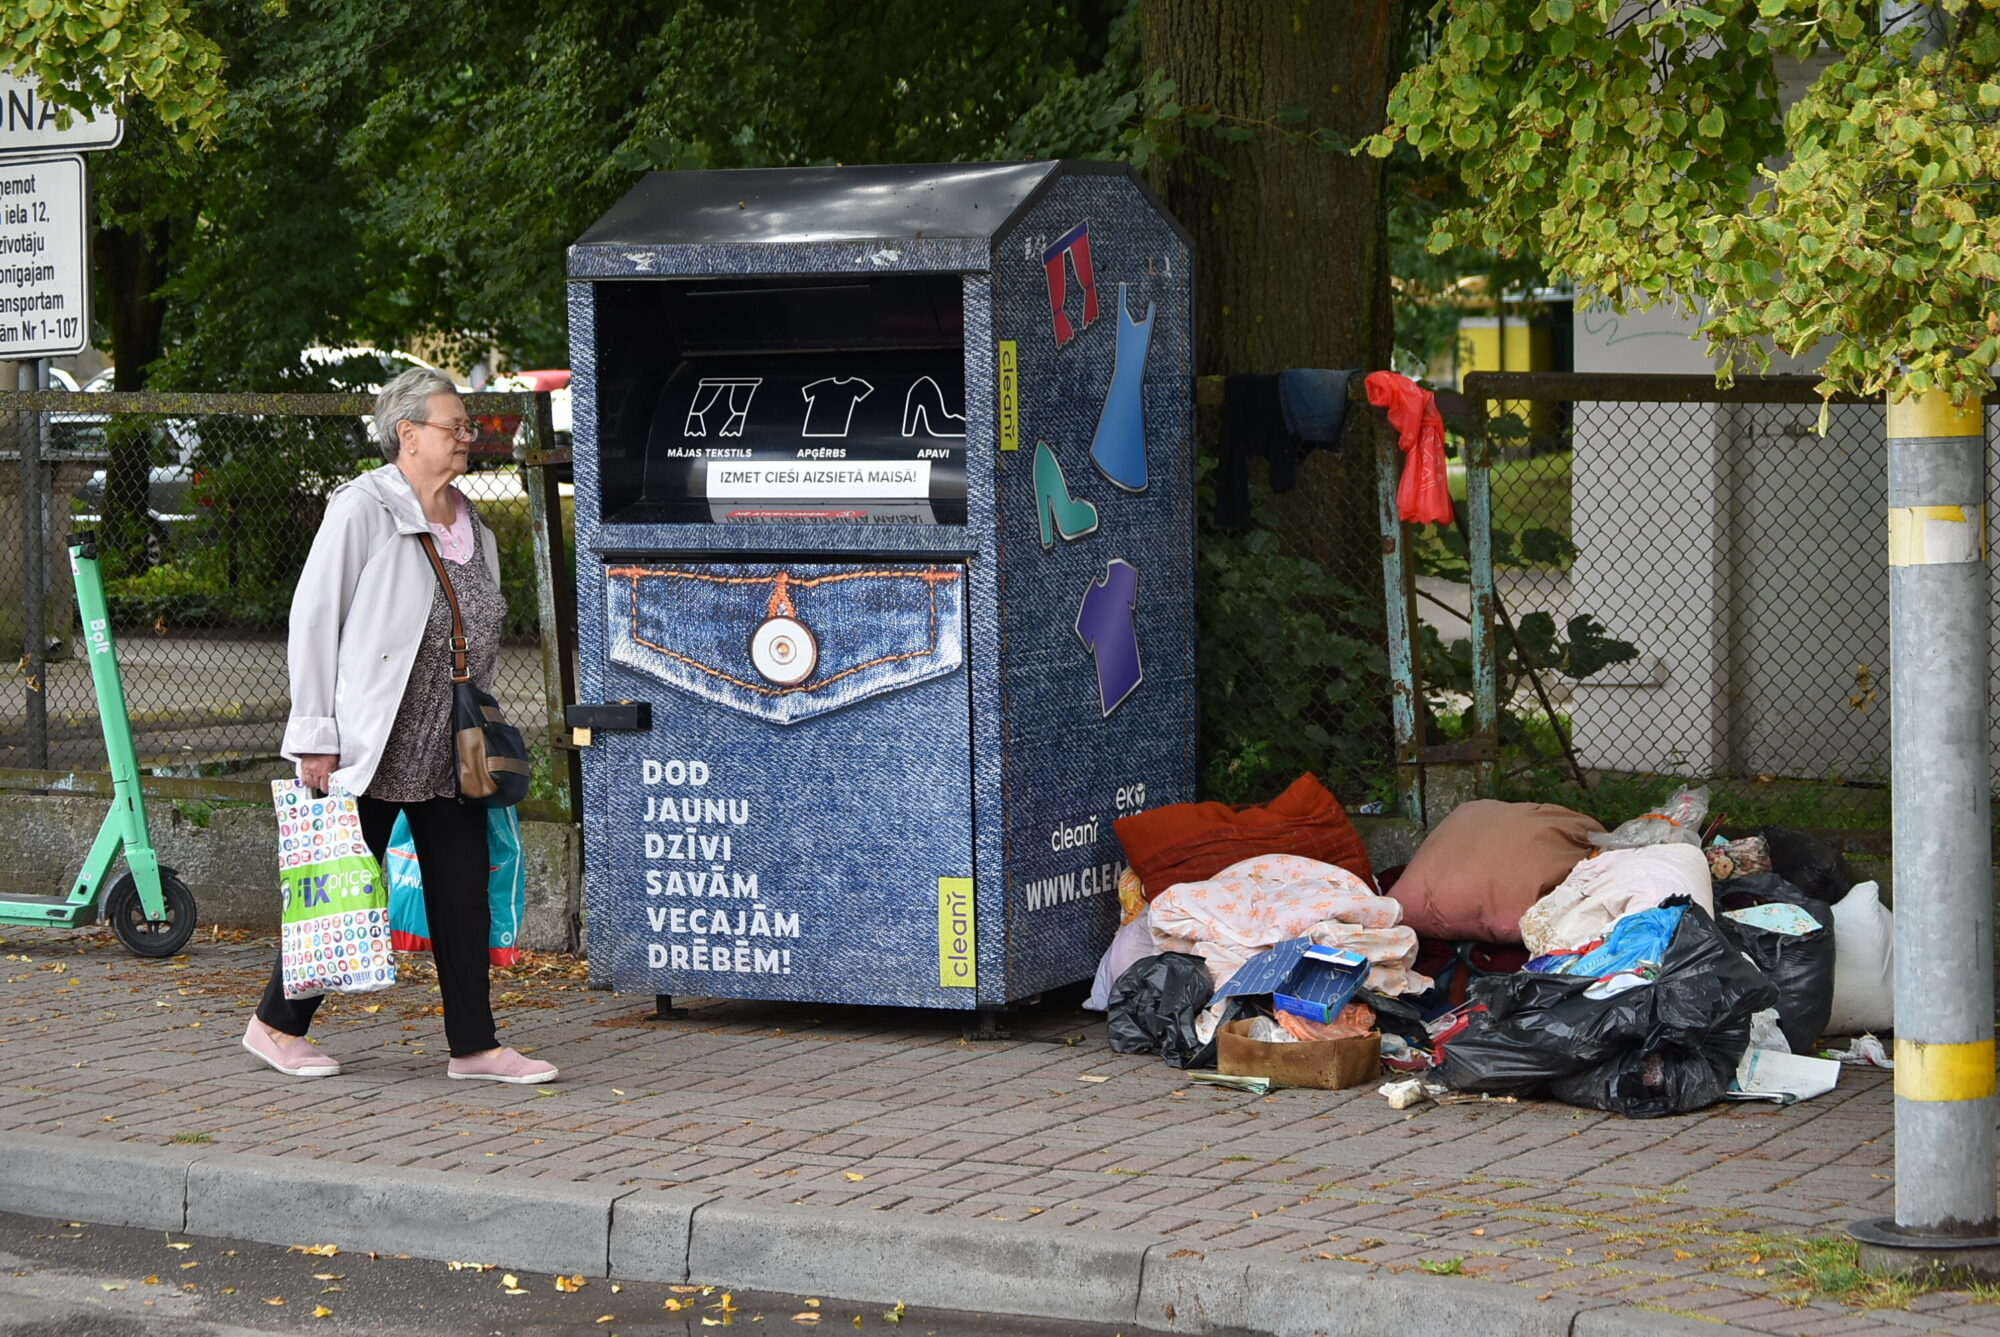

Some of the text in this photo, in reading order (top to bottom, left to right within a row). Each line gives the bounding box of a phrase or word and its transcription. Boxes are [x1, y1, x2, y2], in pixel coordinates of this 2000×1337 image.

[0, 88, 61, 132] NA
[5, 201, 50, 225] iela 12,
[22, 320, 37, 341] Nr
[41, 317, 78, 340] 1-107
[667, 446, 752, 458] MĀJAS TEKSTILS
[796, 447, 847, 461] APĢĒRBS
[917, 449, 950, 459] APAVI
[720, 468, 917, 484] IZMET CIEŠI AIZSIETĀ MAISĀ!
[89, 618, 110, 655] Bolt
[642, 759, 709, 786] DOD
[643, 797, 749, 825] JAUNU
[644, 827, 732, 861] DZĪVI
[328, 869, 373, 893] price
[646, 865, 758, 899] SAVĀM
[1025, 859, 1129, 912] WWW.CLEA
[646, 903, 800, 938] VECAJĀM
[649, 938, 791, 975] DRĒBĒM!
